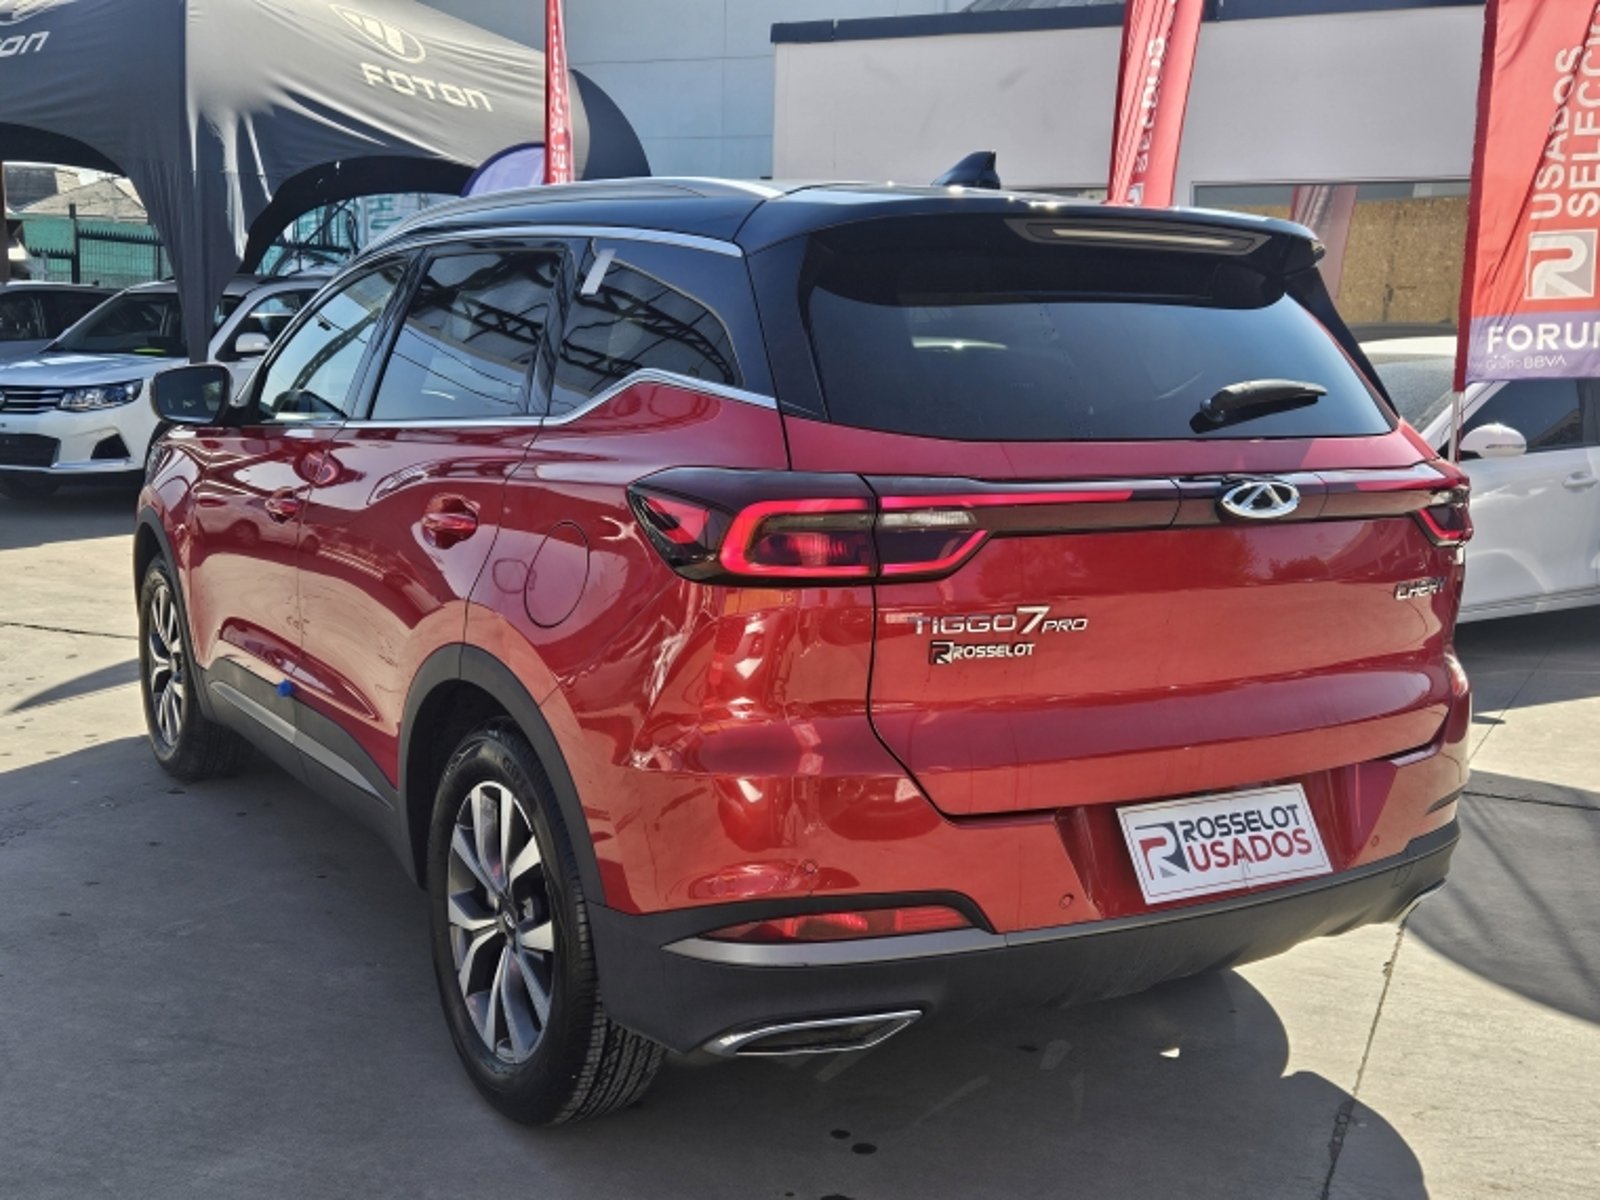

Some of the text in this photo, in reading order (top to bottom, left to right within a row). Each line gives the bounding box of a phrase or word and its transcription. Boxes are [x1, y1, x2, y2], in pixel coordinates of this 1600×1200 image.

[1530, 46, 1583, 220] USADOS
[953, 643, 1036, 660] ROSSELOT
[1179, 804, 1300, 842] ROSSELOT
[1187, 828, 1312, 872] USADOS
